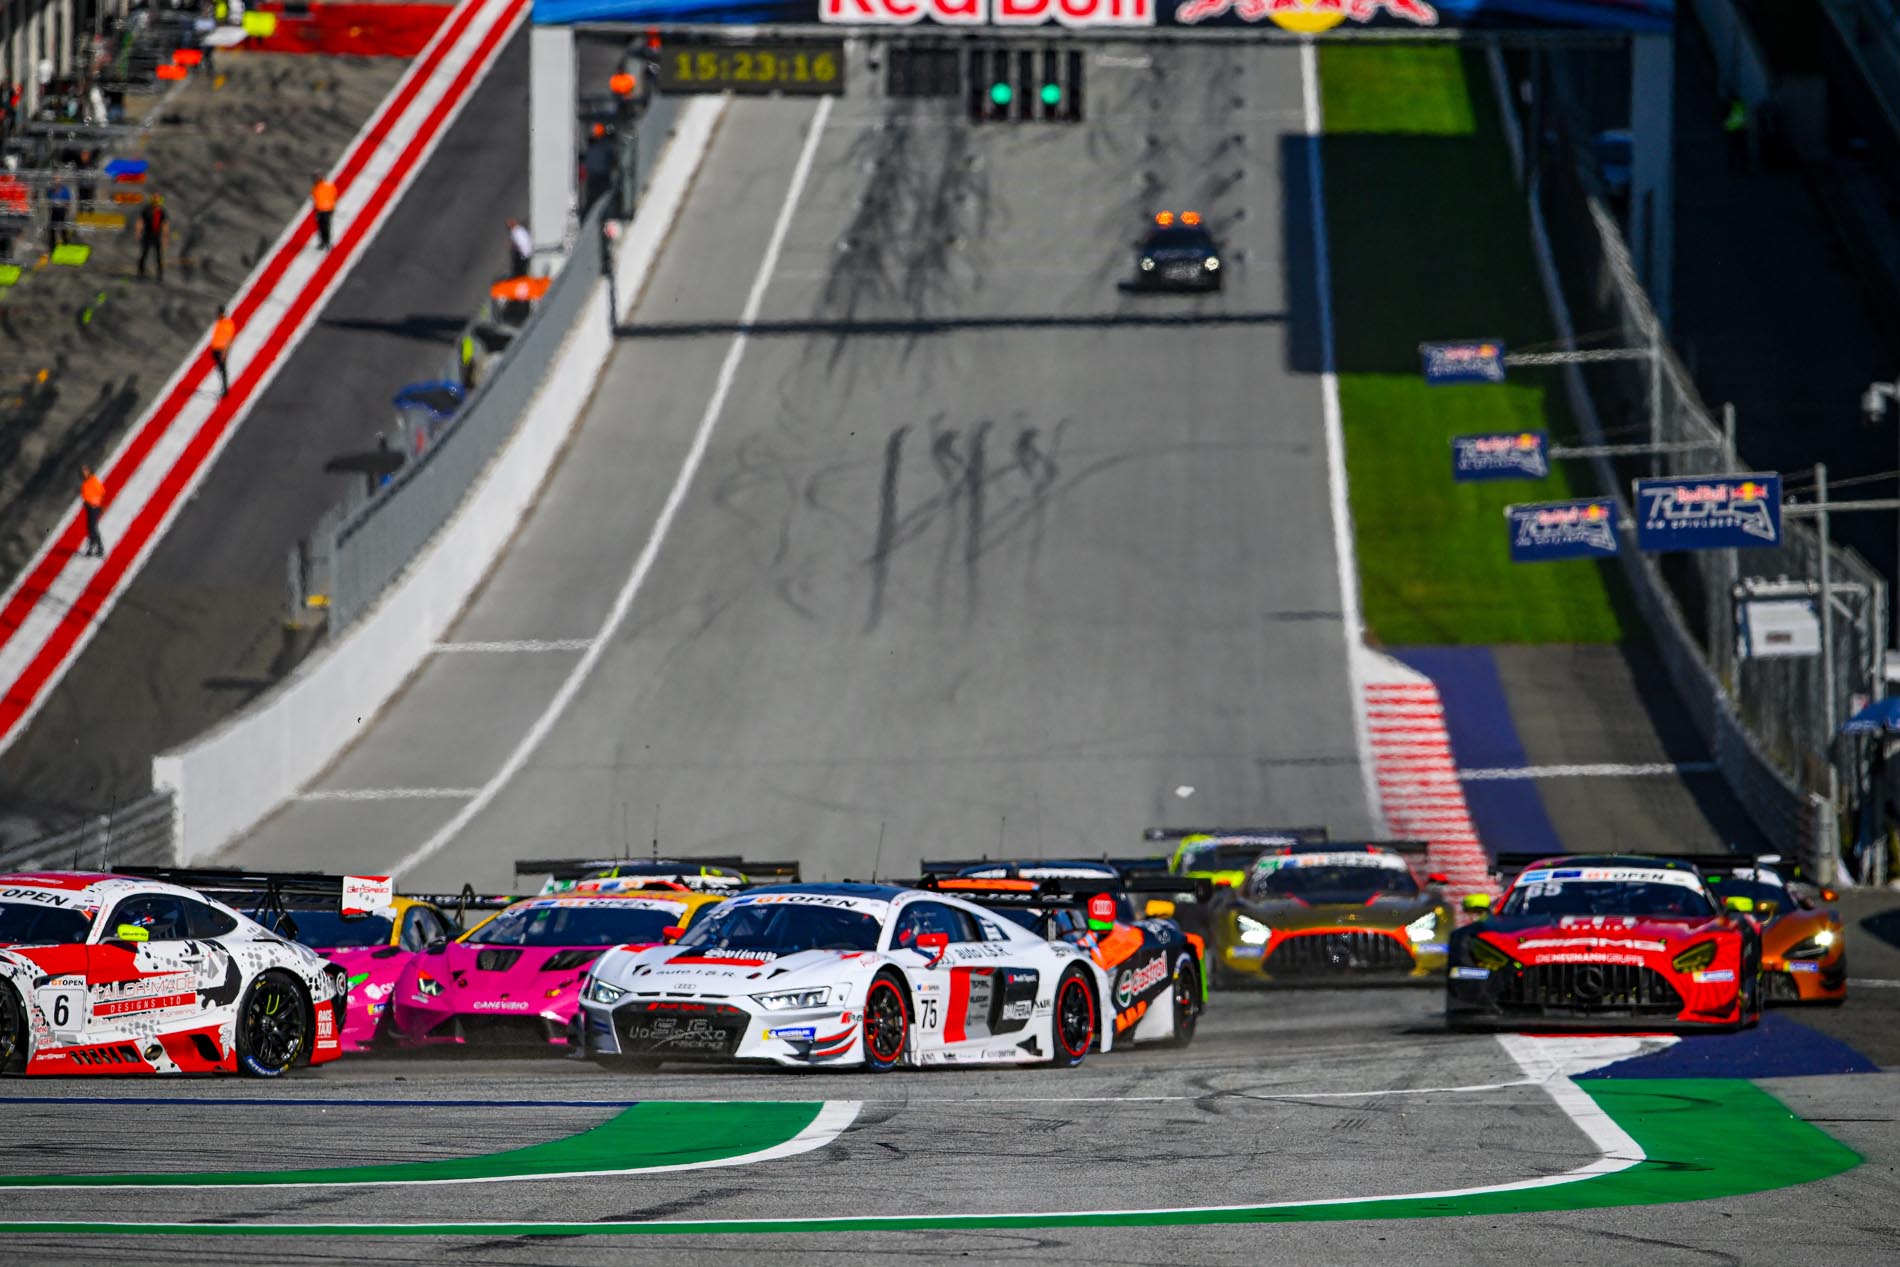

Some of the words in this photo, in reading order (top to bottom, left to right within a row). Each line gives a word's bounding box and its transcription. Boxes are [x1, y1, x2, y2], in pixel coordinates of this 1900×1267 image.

[675, 52, 836, 81] 15:23:16
[2, 888, 69, 907] OPEN
[53, 994, 70, 1027] 6
[110, 999, 156, 1013] DESIGNS
[163, 996, 181, 1006] LTD
[921, 999, 937, 1029] 75
